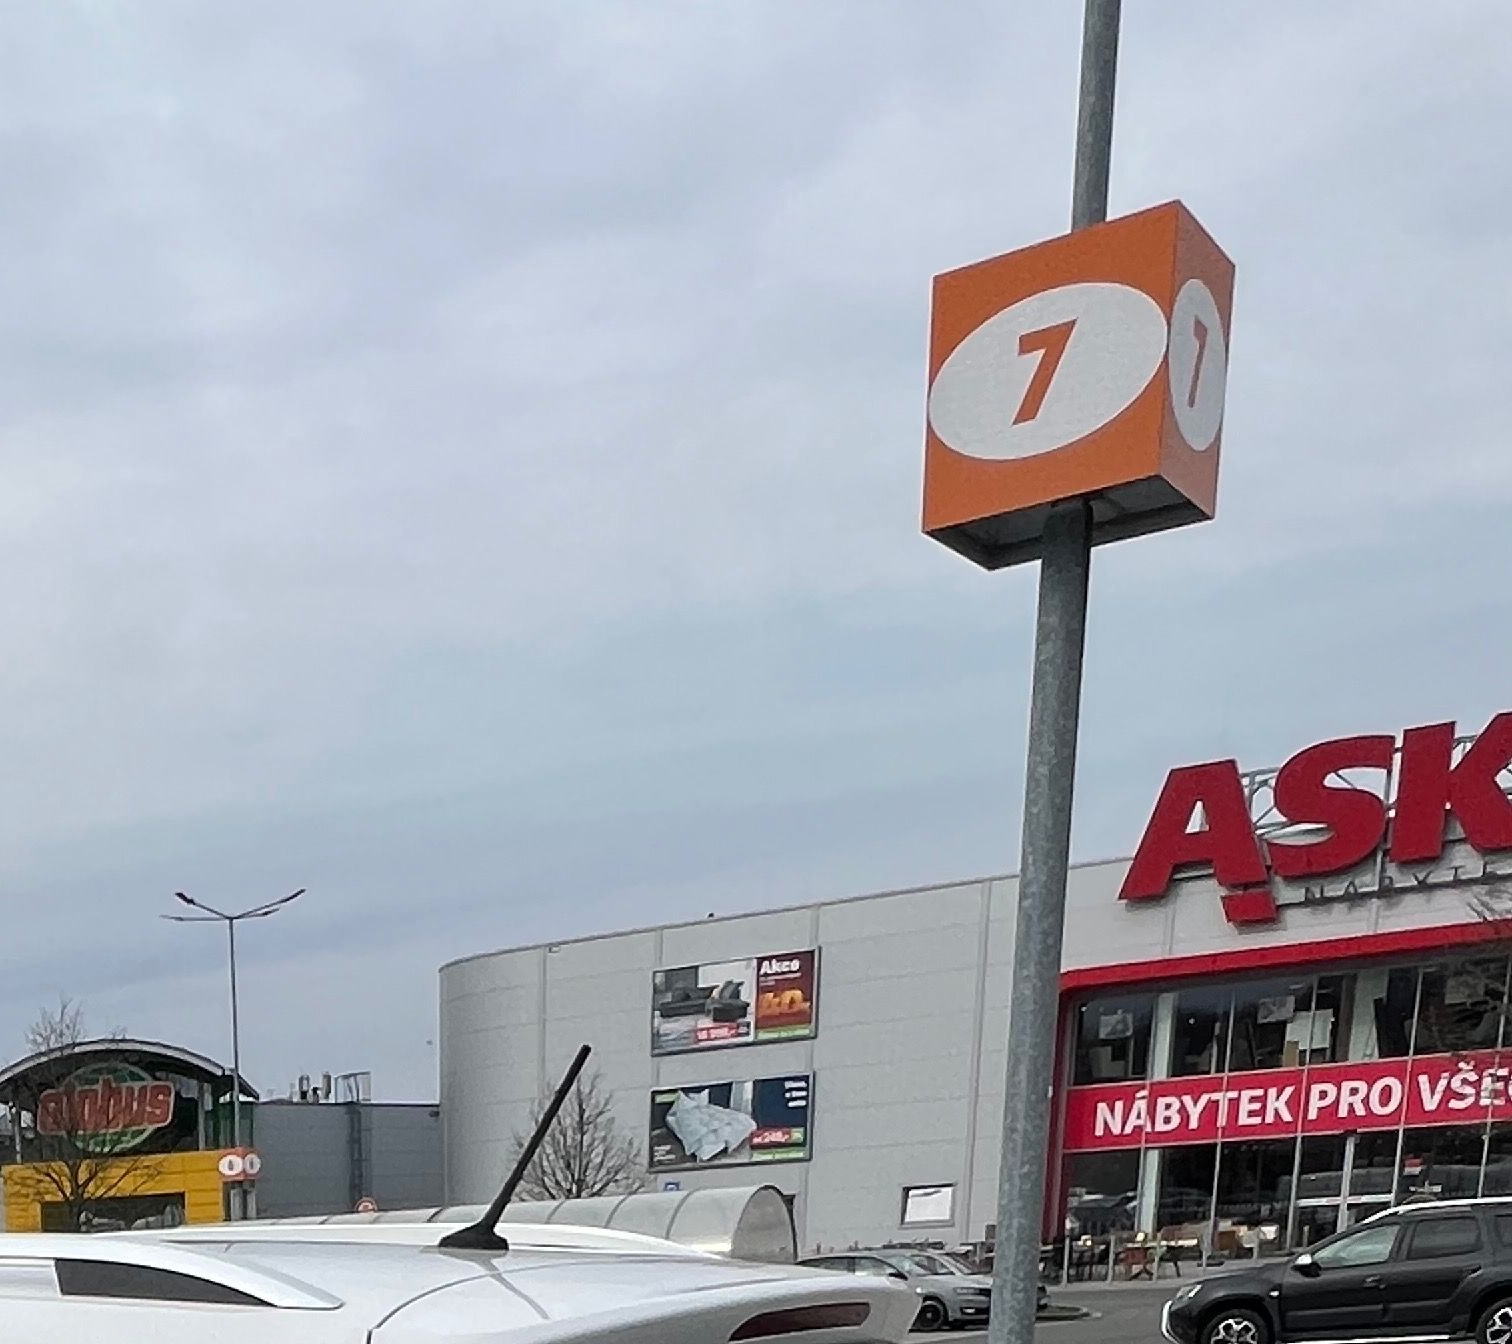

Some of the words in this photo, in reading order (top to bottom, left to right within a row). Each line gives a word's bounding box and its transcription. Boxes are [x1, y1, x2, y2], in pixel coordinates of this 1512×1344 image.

[1012, 319, 1078, 426] 7
[1118, 711, 1512, 905] ASK
[1094, 1084, 1295, 1137] NÁBYTEK
[1306, 1076, 1403, 1122] PRO
[1417, 1060, 1512, 1112] VŠE
